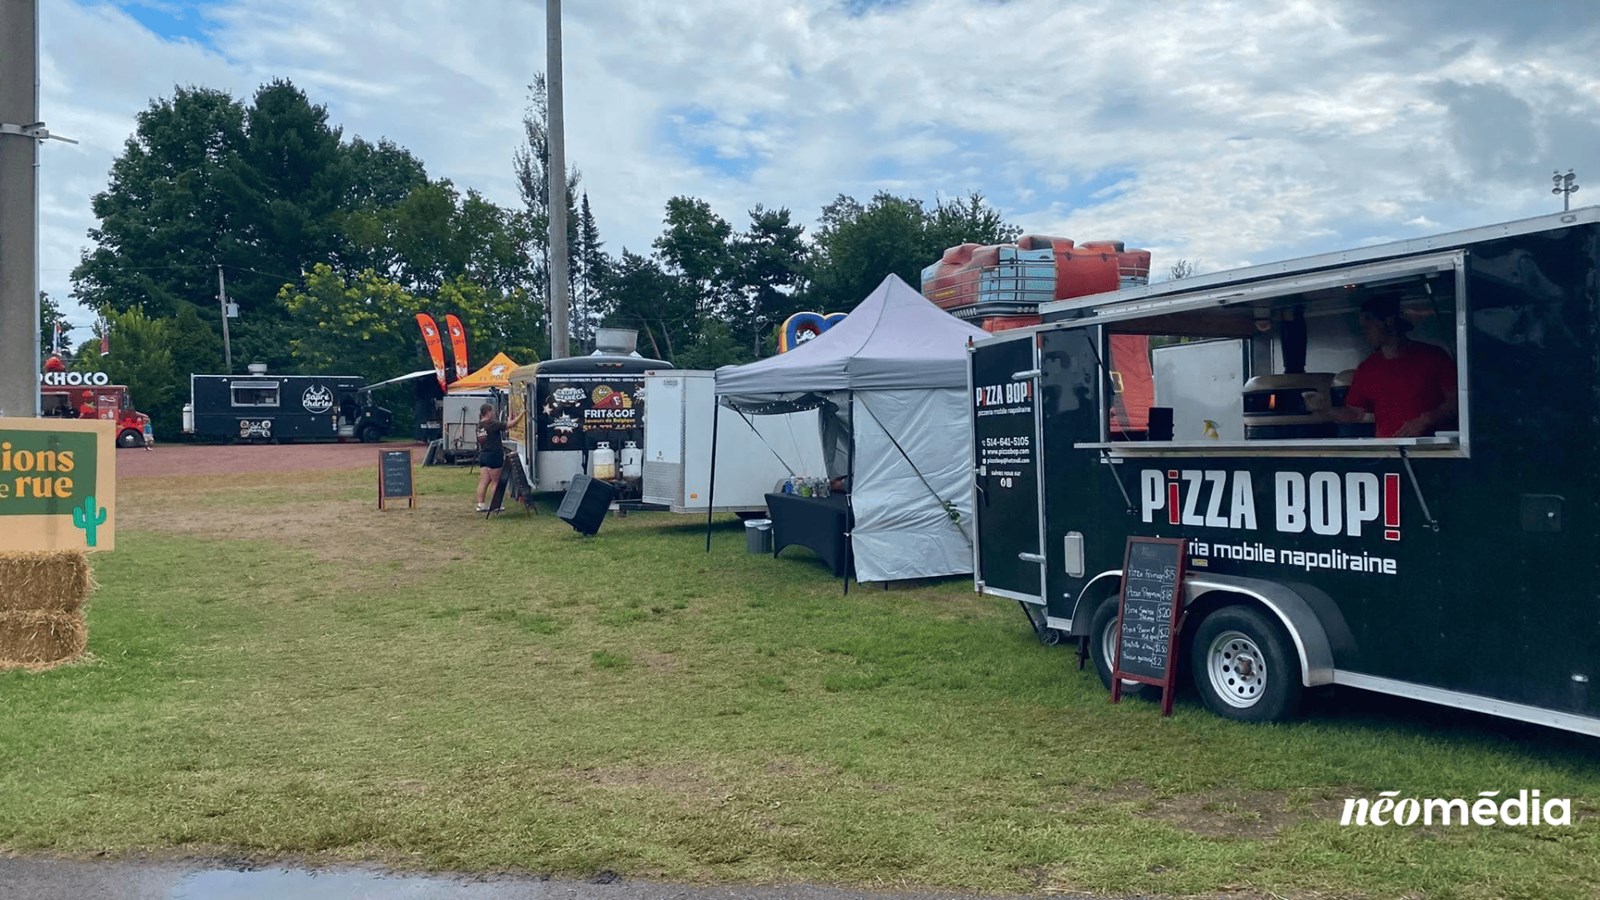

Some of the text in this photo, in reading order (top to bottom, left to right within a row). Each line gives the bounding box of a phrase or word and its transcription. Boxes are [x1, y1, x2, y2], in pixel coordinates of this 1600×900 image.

[1006, 381, 1032, 403] BOP!
[584, 409, 635, 418] FRIT&GOF
[994, 407, 1007, 415] mobile
[986, 437, 1029, 447] 514-641-5105
[987, 447, 1030, 456] www.pizzabop.com
[15, 476, 73, 498] rue
[1275, 471, 1400, 541] BOP!
[1187, 537, 1209, 555] ria
[1213, 541, 1275, 563] mobile
[1280, 548, 1397, 575] napolitaine
[1158, 606, 1171, 618] $20
